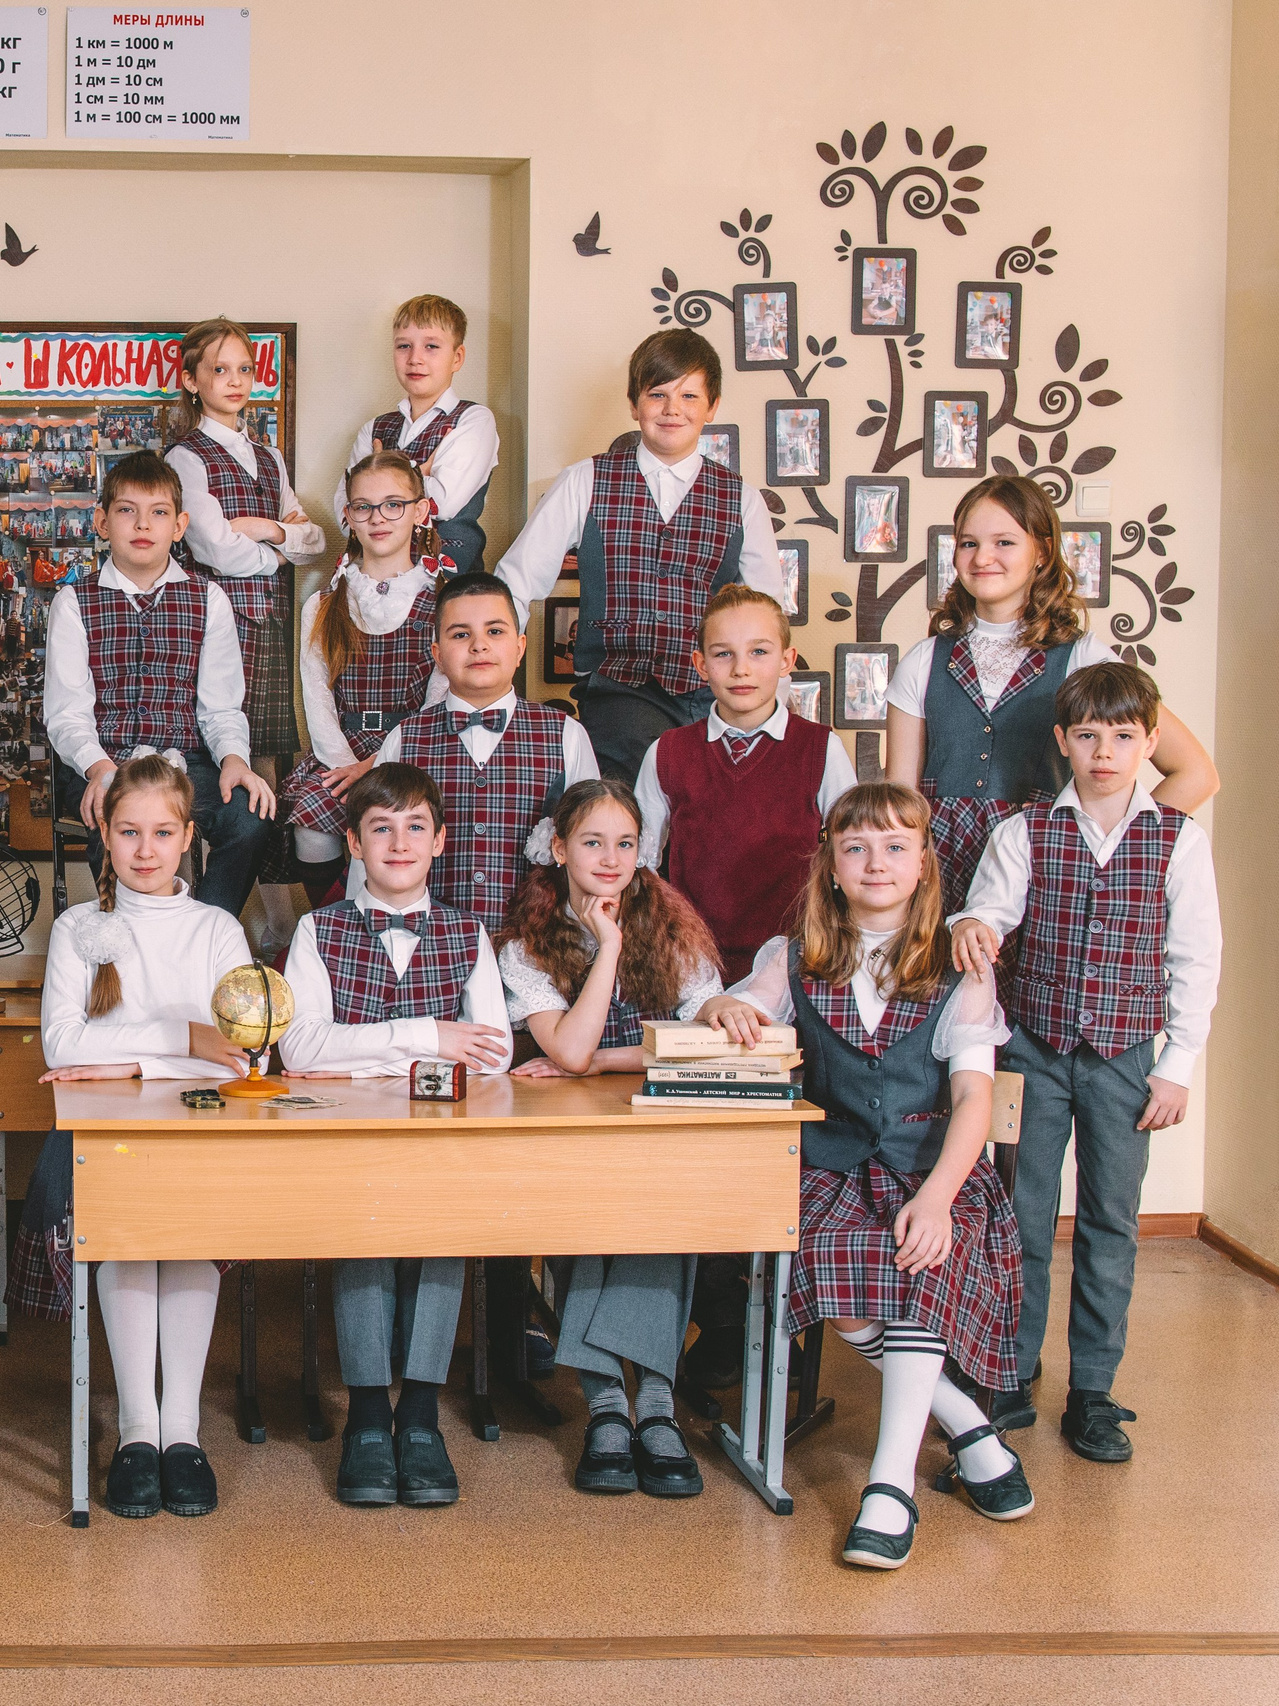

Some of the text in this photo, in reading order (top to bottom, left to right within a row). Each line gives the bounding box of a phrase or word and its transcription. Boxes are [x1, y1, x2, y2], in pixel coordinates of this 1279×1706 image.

[114, 15, 204, 27] МЕРЫ ДЛИНЫ
[1, 37, 21, 49] кг
[76, 37, 83, 48] 1
[88, 40, 105, 48] км
[126, 38, 159, 49] 1000
[164, 41, 173, 49] м
[12, 62, 21, 73] г
[75, 55, 82, 66] 1
[87, 58, 96, 67] м
[117, 56, 133, 67] 10
[137, 59, 155, 70] дм
[75, 74, 82, 85] 1
[86, 77, 105, 87] дм
[126, 74, 141, 86] 10
[146, 77, 162, 86] см
[75, 92, 82, 103] 1
[87, 95, 103, 104] см
[124, 93, 139, 104] 10
[144, 96, 164, 105] мм
[75, 111, 81, 122] 1
[87, 114, 96, 122] м
[116, 111, 141, 123] 100
[145, 114, 162, 123] см
[182, 112, 215, 124] 1000
[220, 116, 239, 124] мм
